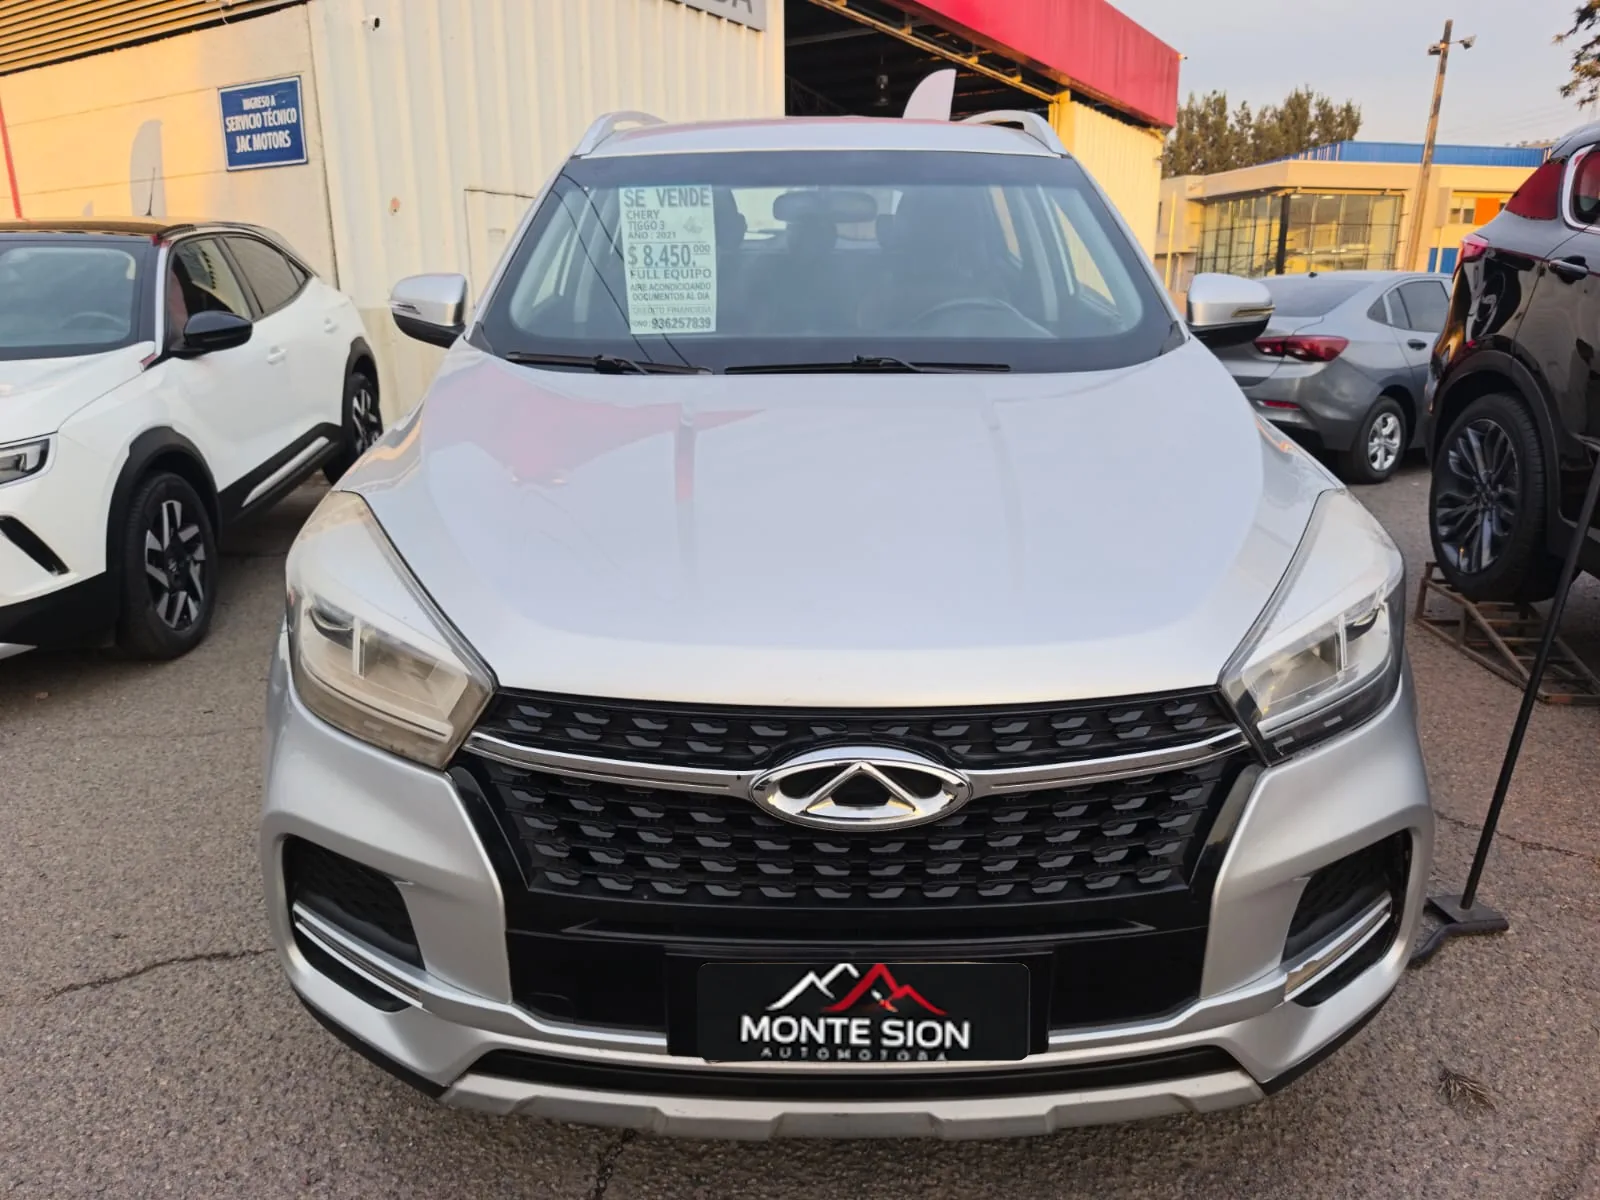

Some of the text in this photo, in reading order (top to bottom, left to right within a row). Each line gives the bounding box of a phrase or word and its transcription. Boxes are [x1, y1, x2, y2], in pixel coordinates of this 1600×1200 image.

[270, 95, 276, 107] A
[225, 108, 297, 132] SERVICIO TÉCNICO
[236, 130, 291, 153] JAC MOTORS
[623, 187, 711, 208] SE VENDE
[626, 209, 660, 220] CHERY
[627, 220, 665, 231] TIGGO 3
[655, 231, 676, 239] 2021
[628, 245, 638, 266] $
[630, 268, 712, 280] FULL EQUIPO
[632, 292, 684, 301] DOCUMENTOS
[686, 291, 694, 300] AL
[651, 316, 711, 329] 936257839
